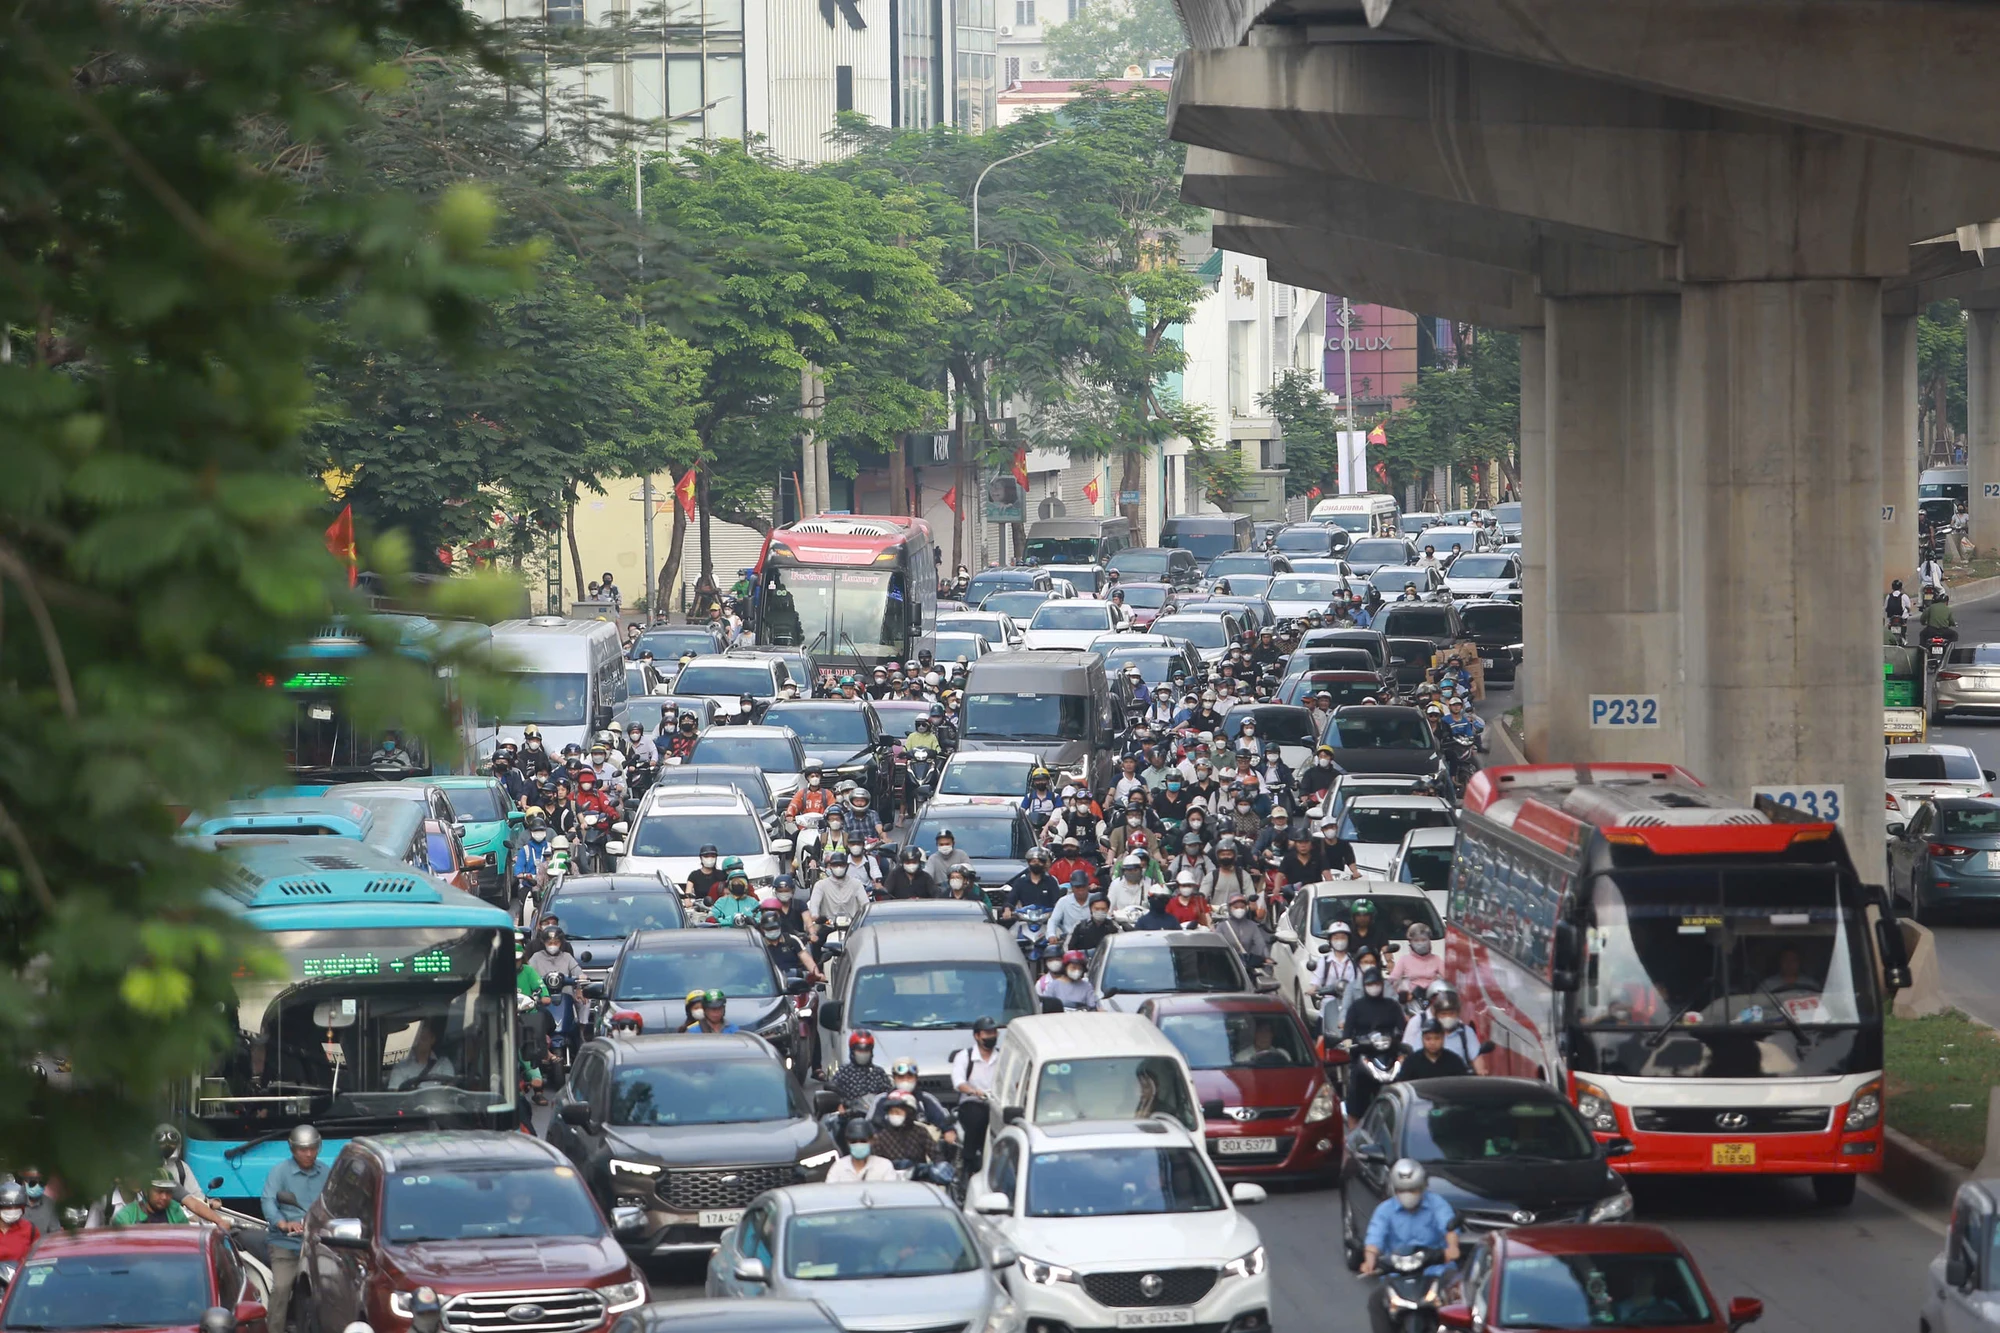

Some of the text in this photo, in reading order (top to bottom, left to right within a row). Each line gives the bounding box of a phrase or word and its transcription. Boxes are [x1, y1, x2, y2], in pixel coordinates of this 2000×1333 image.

[933, 434, 949, 461] KRIK
[791, 571, 832, 581] Festival
[841, 572, 879, 585] Luxury
[1592, 699, 1657, 725] P232
